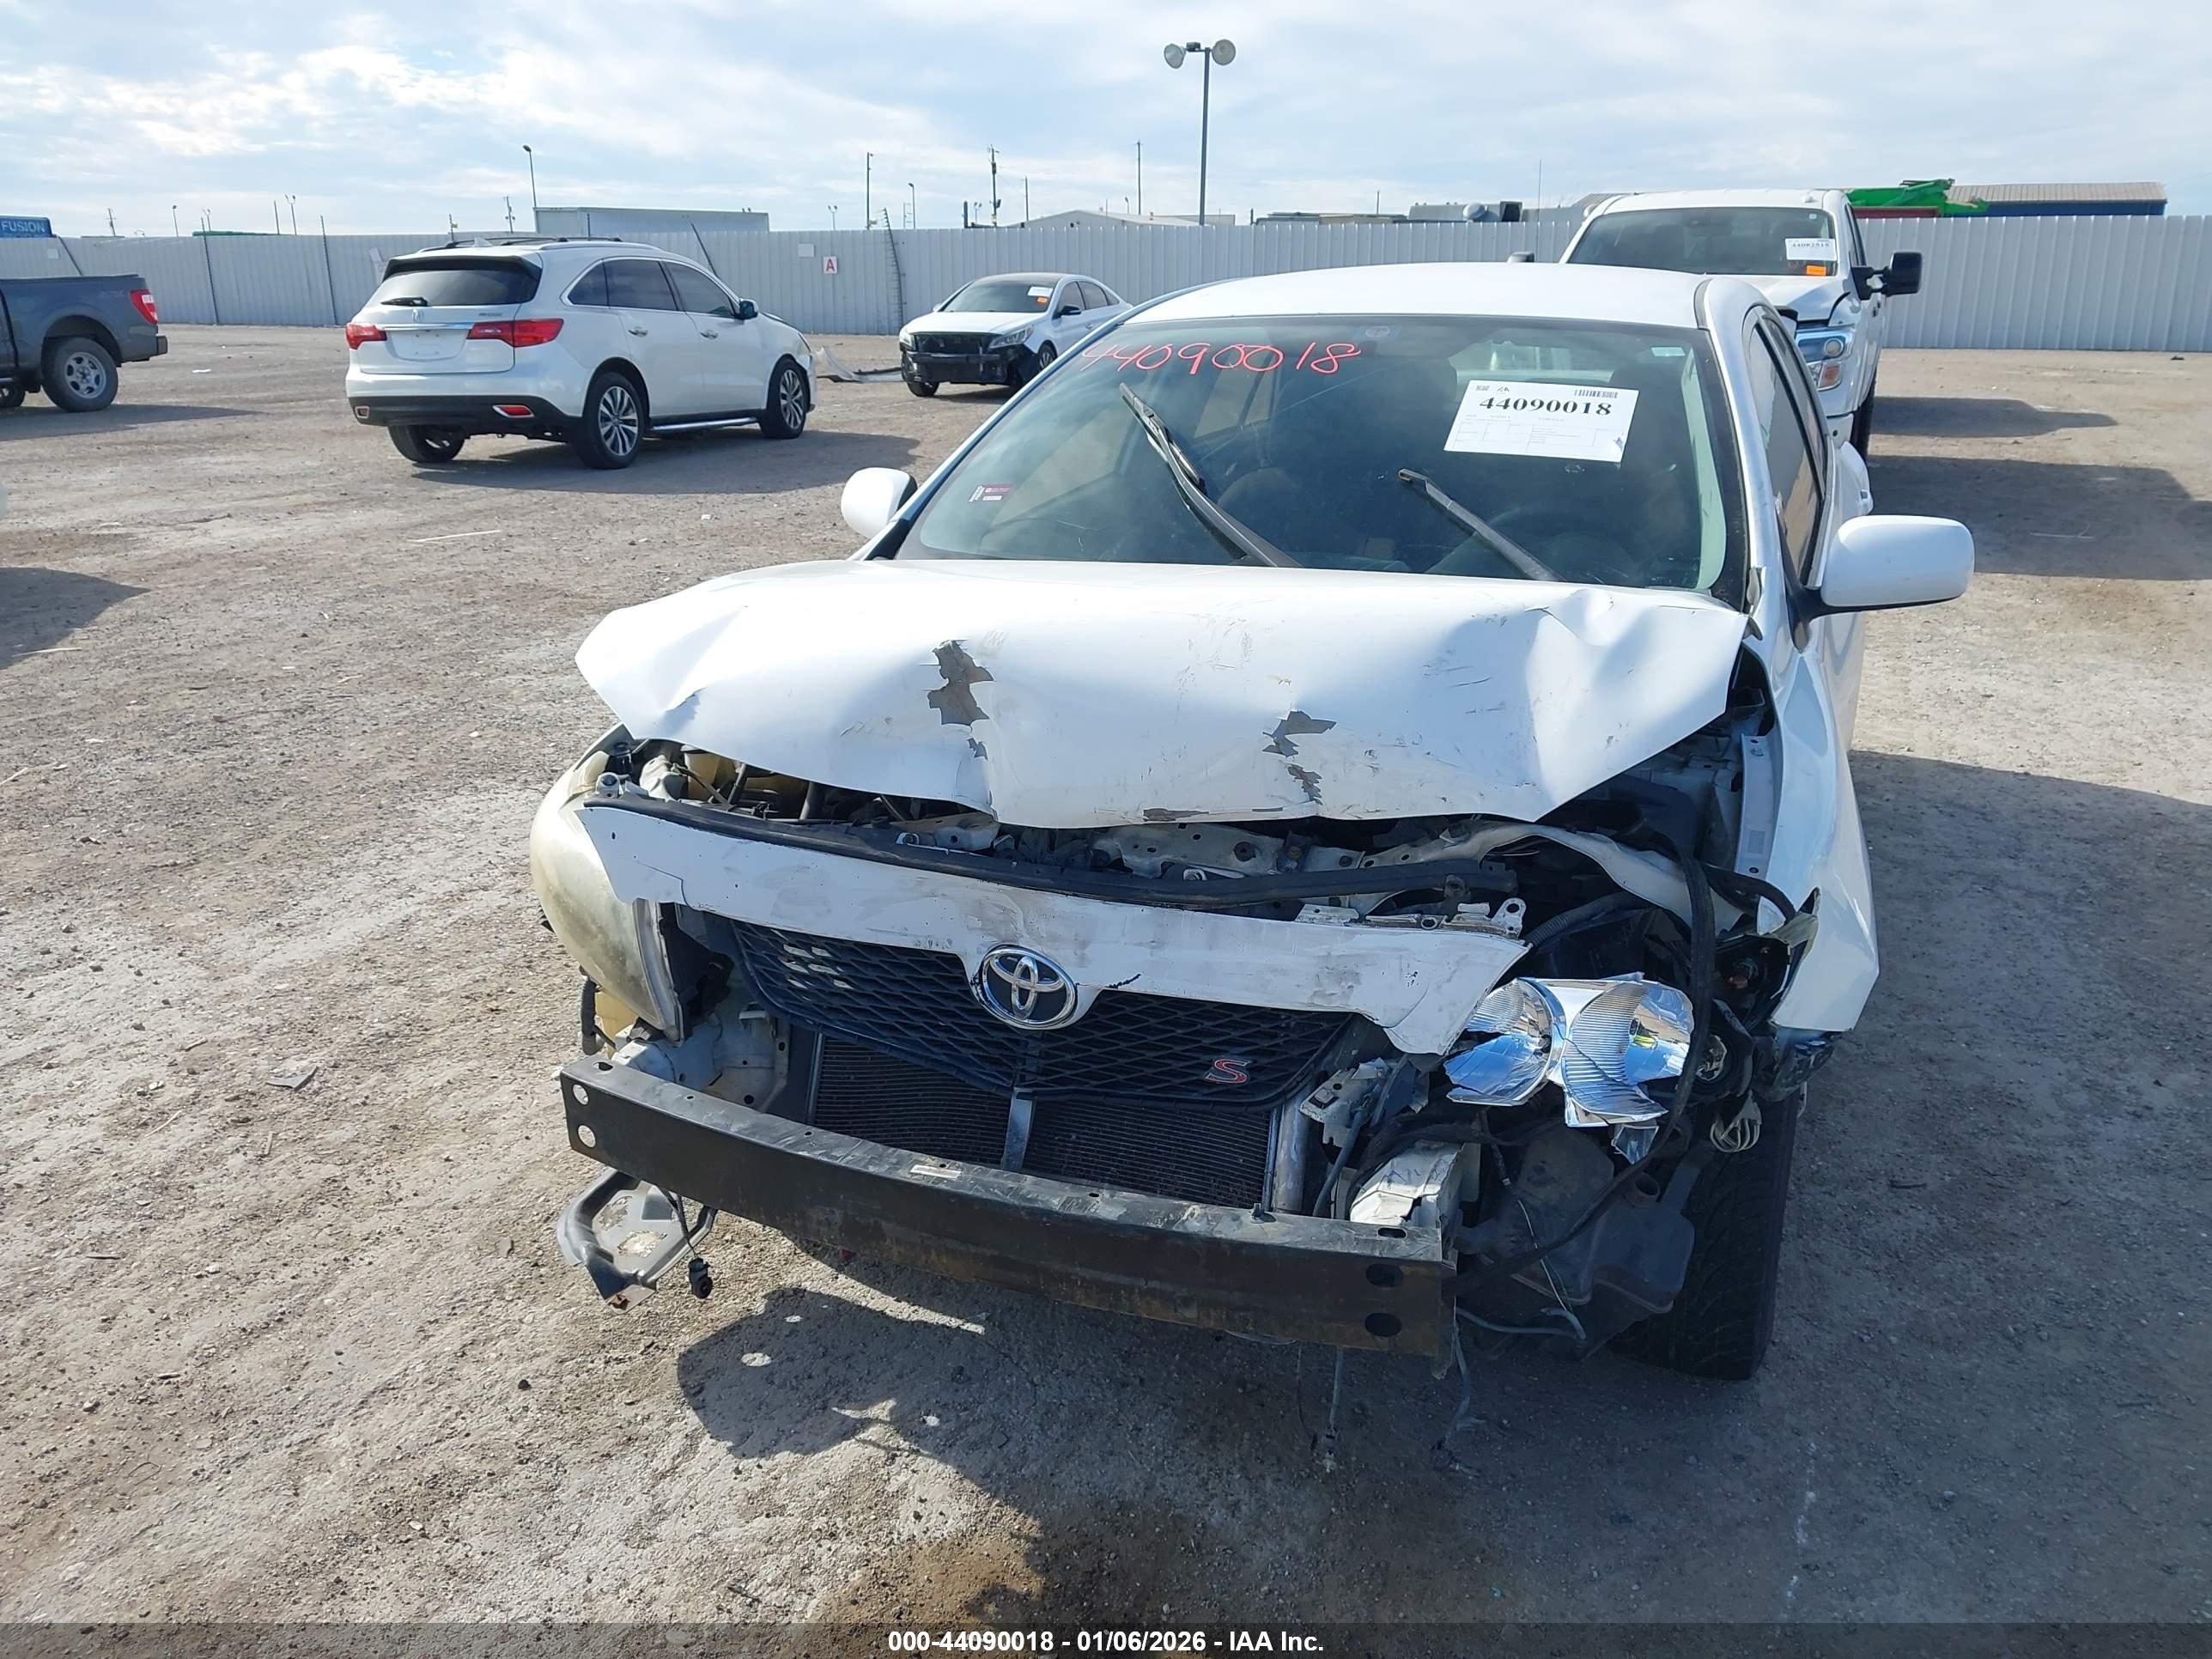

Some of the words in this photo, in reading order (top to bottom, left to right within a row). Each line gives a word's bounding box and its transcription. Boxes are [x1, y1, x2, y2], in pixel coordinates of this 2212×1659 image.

[1, 221, 46, 233] FUSION
[825, 258, 836, 272] A
[1079, 342, 1362, 376] 44090018
[1479, 396, 1613, 416] 44090018
[1205, 1059, 1251, 1084] S
